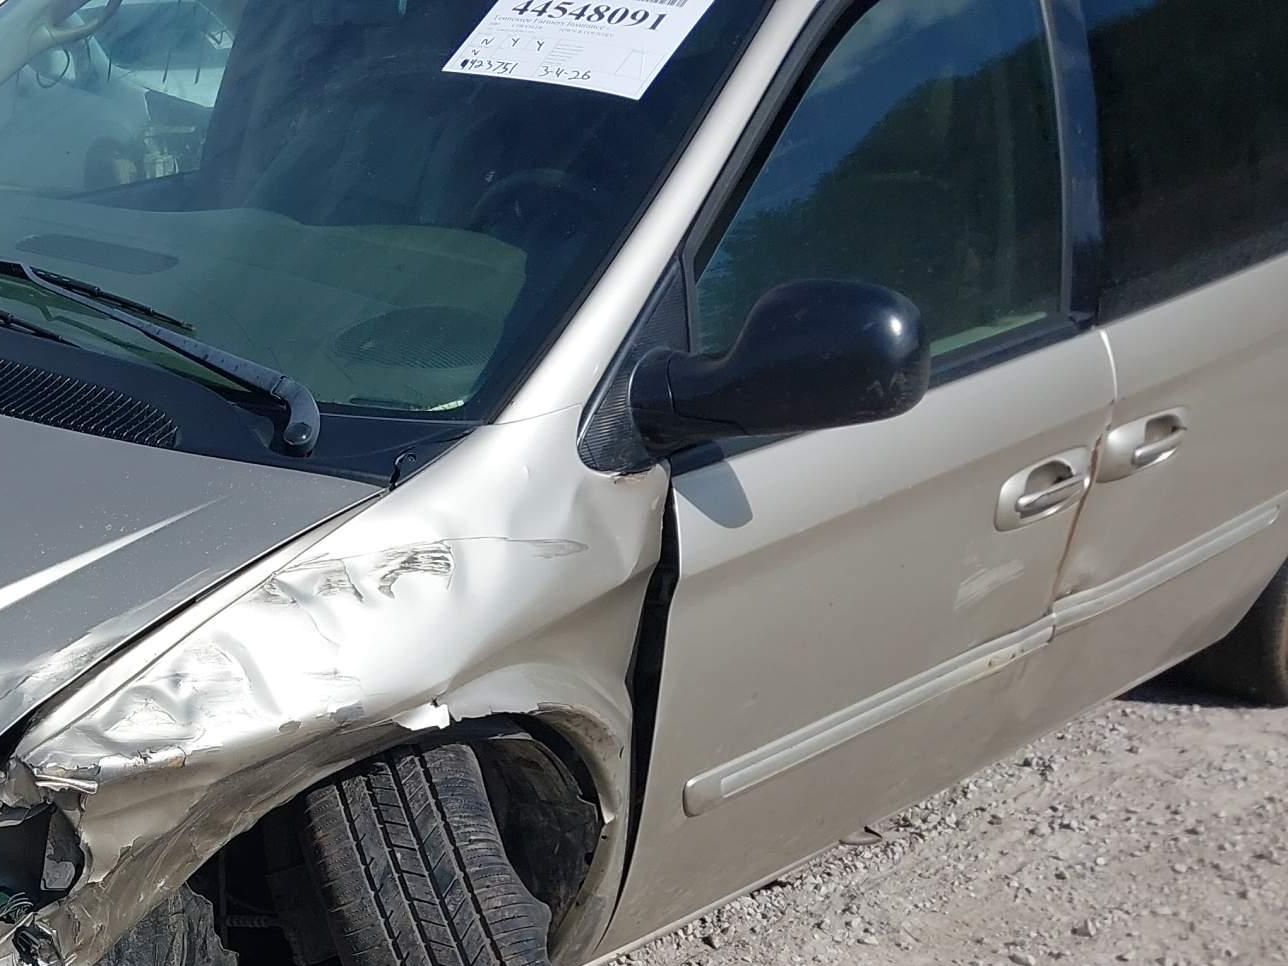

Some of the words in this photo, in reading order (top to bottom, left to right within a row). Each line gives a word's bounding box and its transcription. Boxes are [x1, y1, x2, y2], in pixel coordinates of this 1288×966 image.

[512, 0, 669, 31] 44548091
[511, 37, 520, 47] Y
[536, 40, 544, 51] Y
